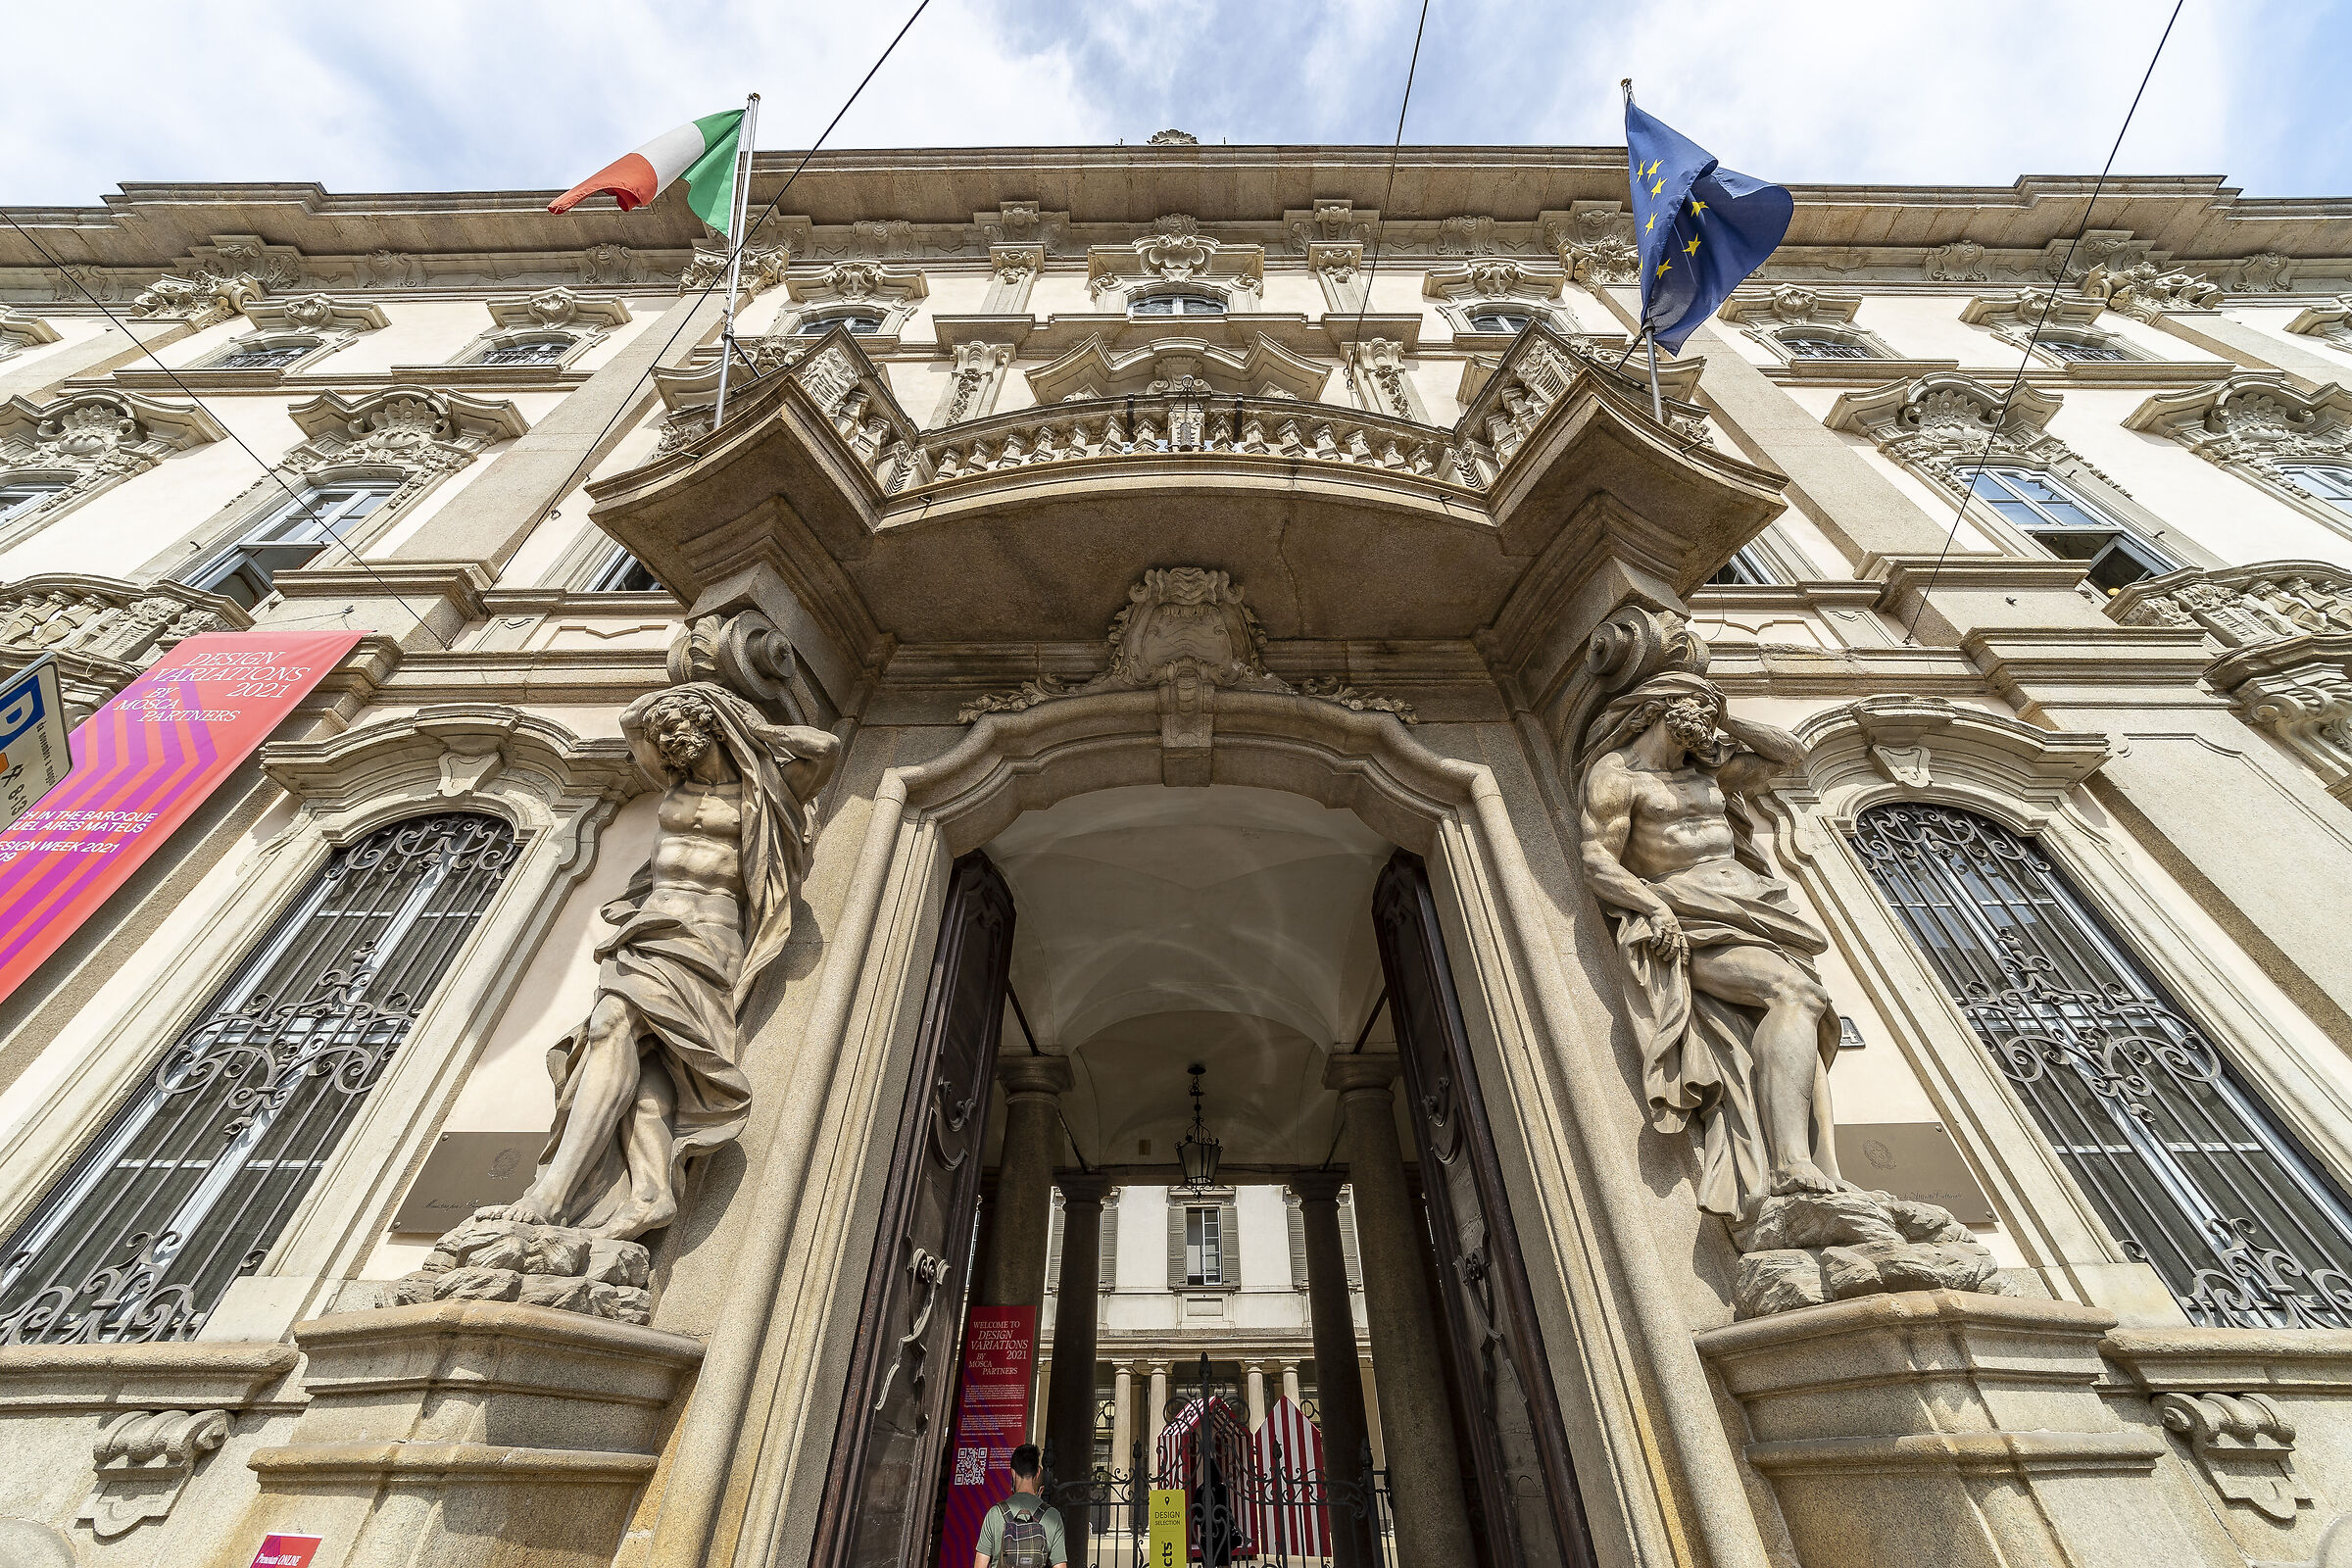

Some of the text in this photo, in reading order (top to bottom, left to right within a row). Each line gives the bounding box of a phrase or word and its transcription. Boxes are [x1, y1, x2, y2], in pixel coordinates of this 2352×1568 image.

[181, 651, 286, 666] DESIGN
[151, 666, 312, 682] VARIATIONS
[145, 687, 180, 699] BY
[225, 682, 291, 698] 2021
[113, 699, 180, 710] MOSCA
[0, 690, 34, 736] P
[136, 710, 241, 722] PARTNERS
[36, 720, 47, 732] da
[39, 731, 53, 761] novembre
[8, 783, 28, 815] 8-13
[35, 810, 57, 820] IN
[54, 810, 86, 820] THE
[81, 810, 159, 823] BAROQUE
[38, 820, 86, 832] AIRES
[82, 821, 147, 834] MATEUS
[38, 840, 83, 852] WEEK
[80, 842, 121, 854] 2021
[973, 1320, 1020, 1329] WELCOME TO
[978, 1330, 1013, 1340] DESIGN
[971, 1340, 1029, 1350] VARIATIONS
[1005, 1349, 1027, 1360] 2021
